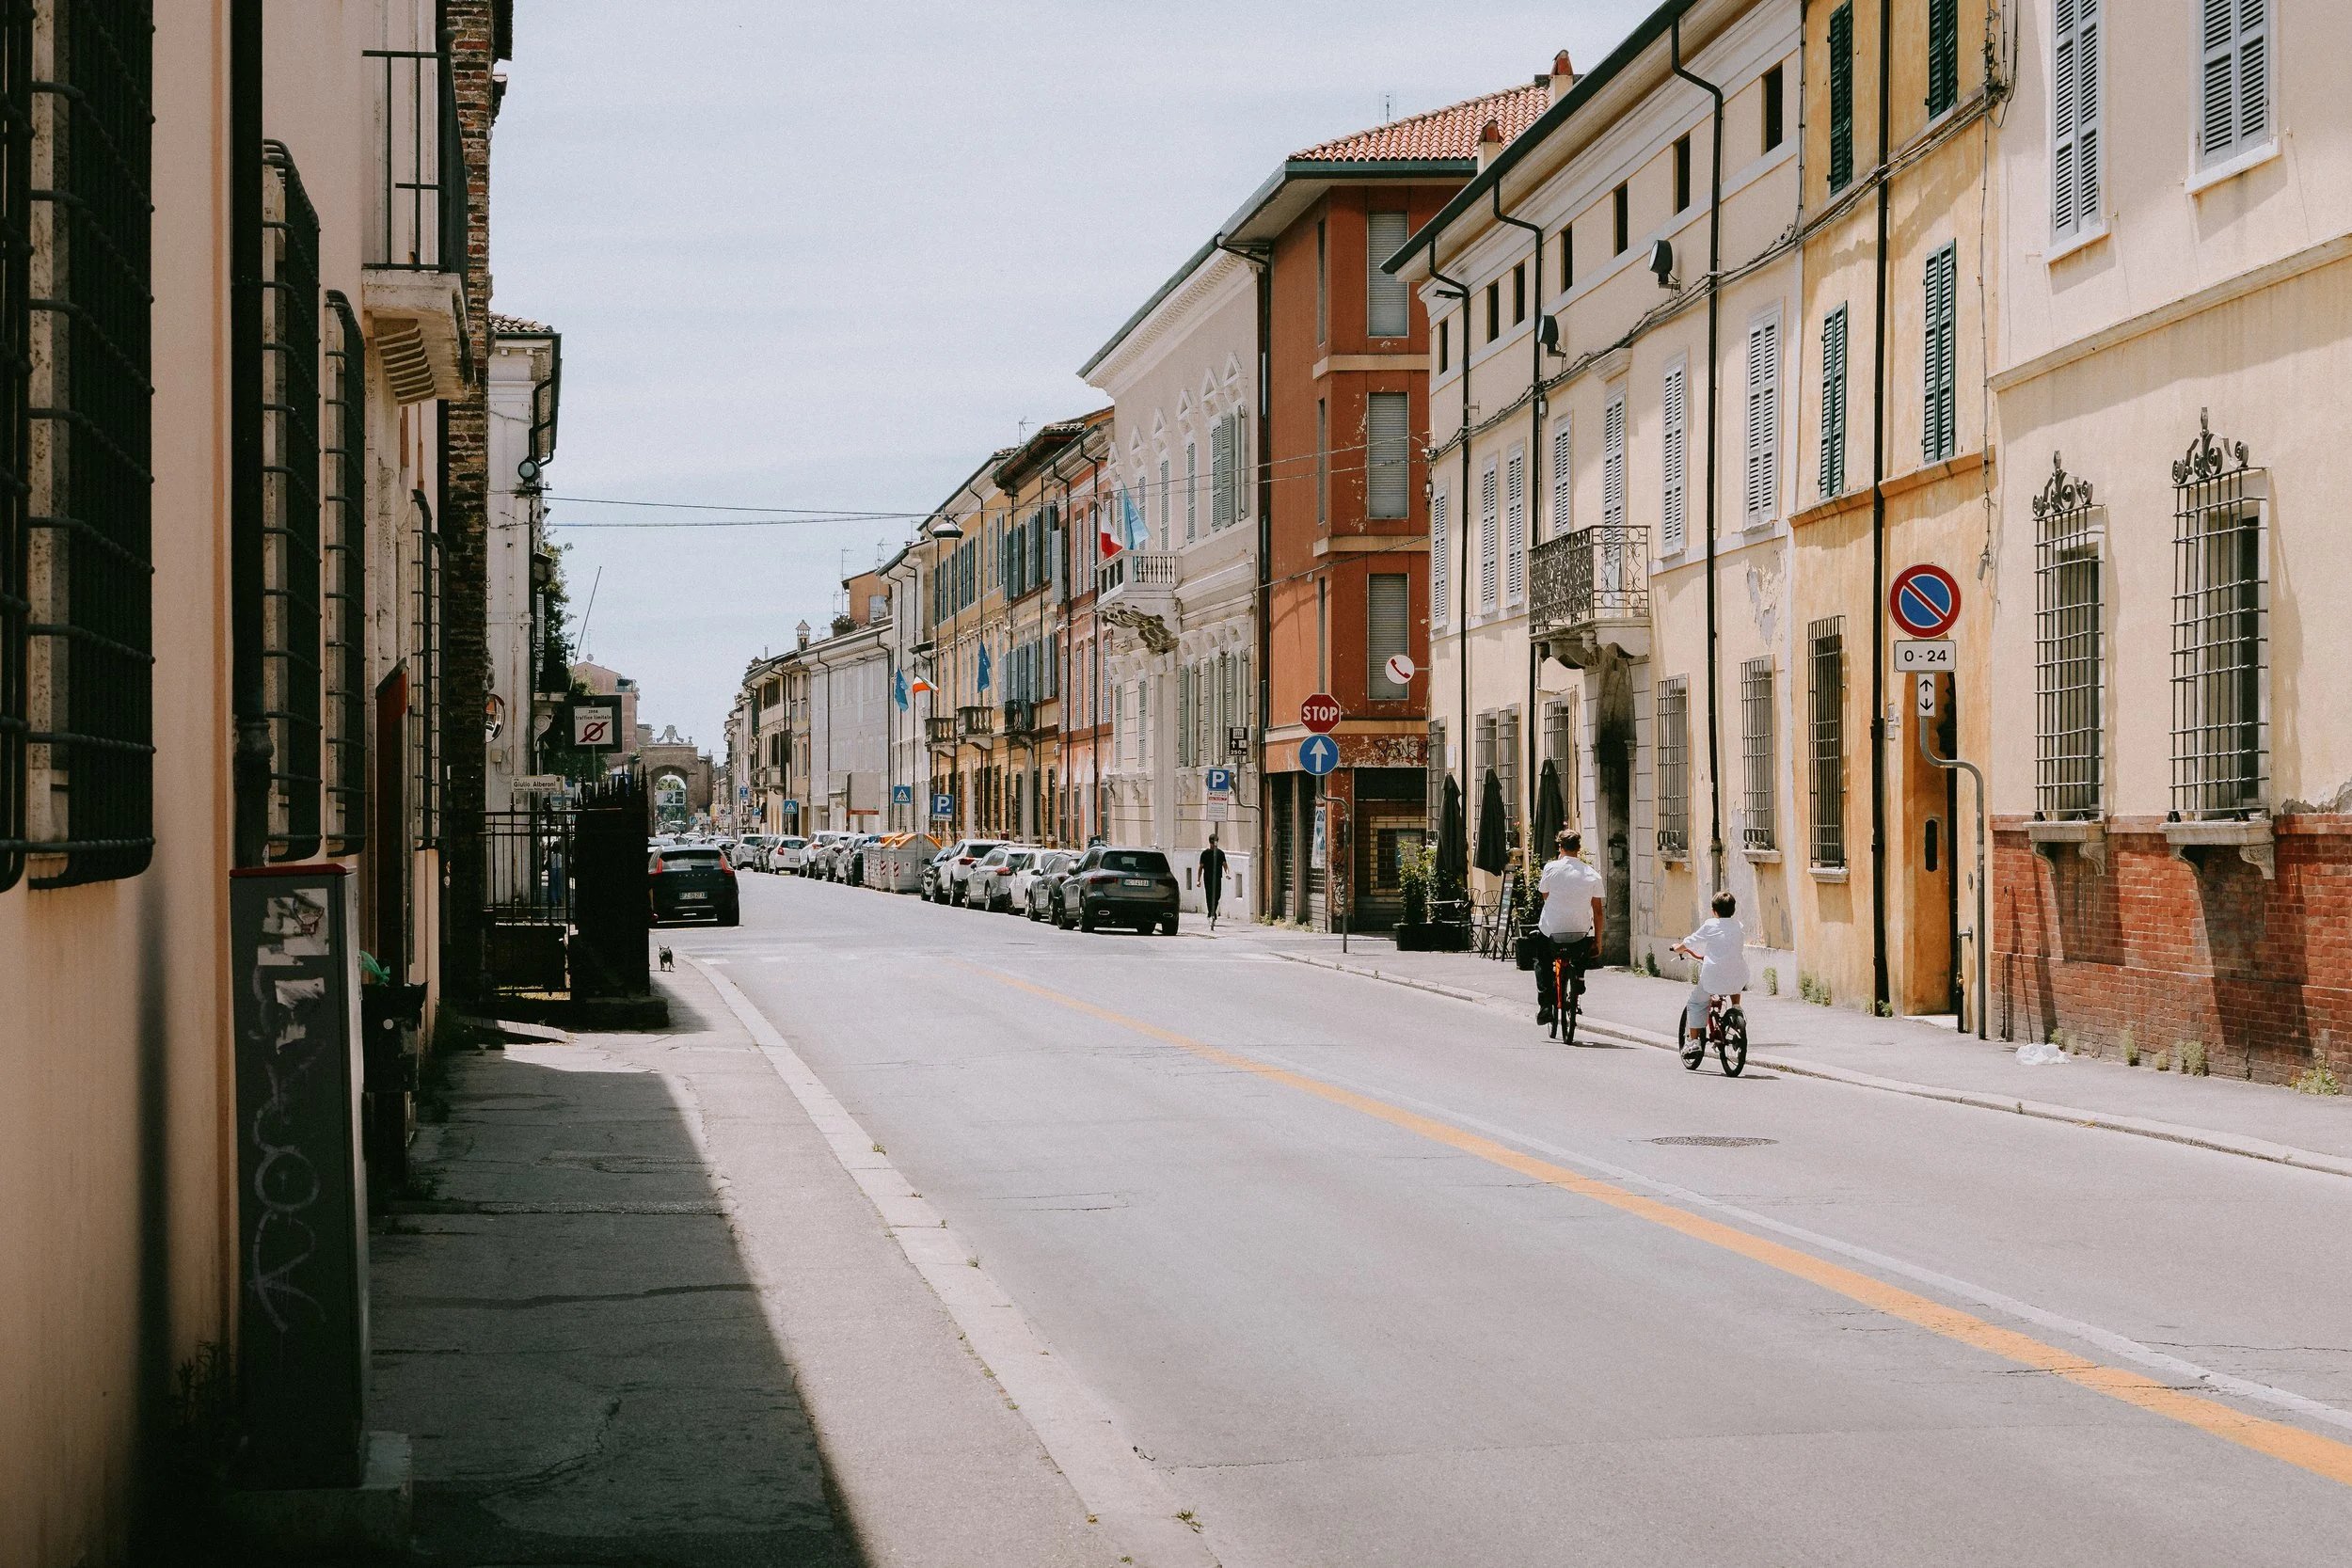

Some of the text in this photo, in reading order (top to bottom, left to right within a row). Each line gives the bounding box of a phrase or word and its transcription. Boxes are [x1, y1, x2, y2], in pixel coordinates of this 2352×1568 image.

[1904, 650, 1914, 662] 0
[1927, 650, 1947, 662] 24
[1303, 705, 1338, 721] STOP
[1212, 771, 1226, 788] P
[937, 796, 950, 812] P
